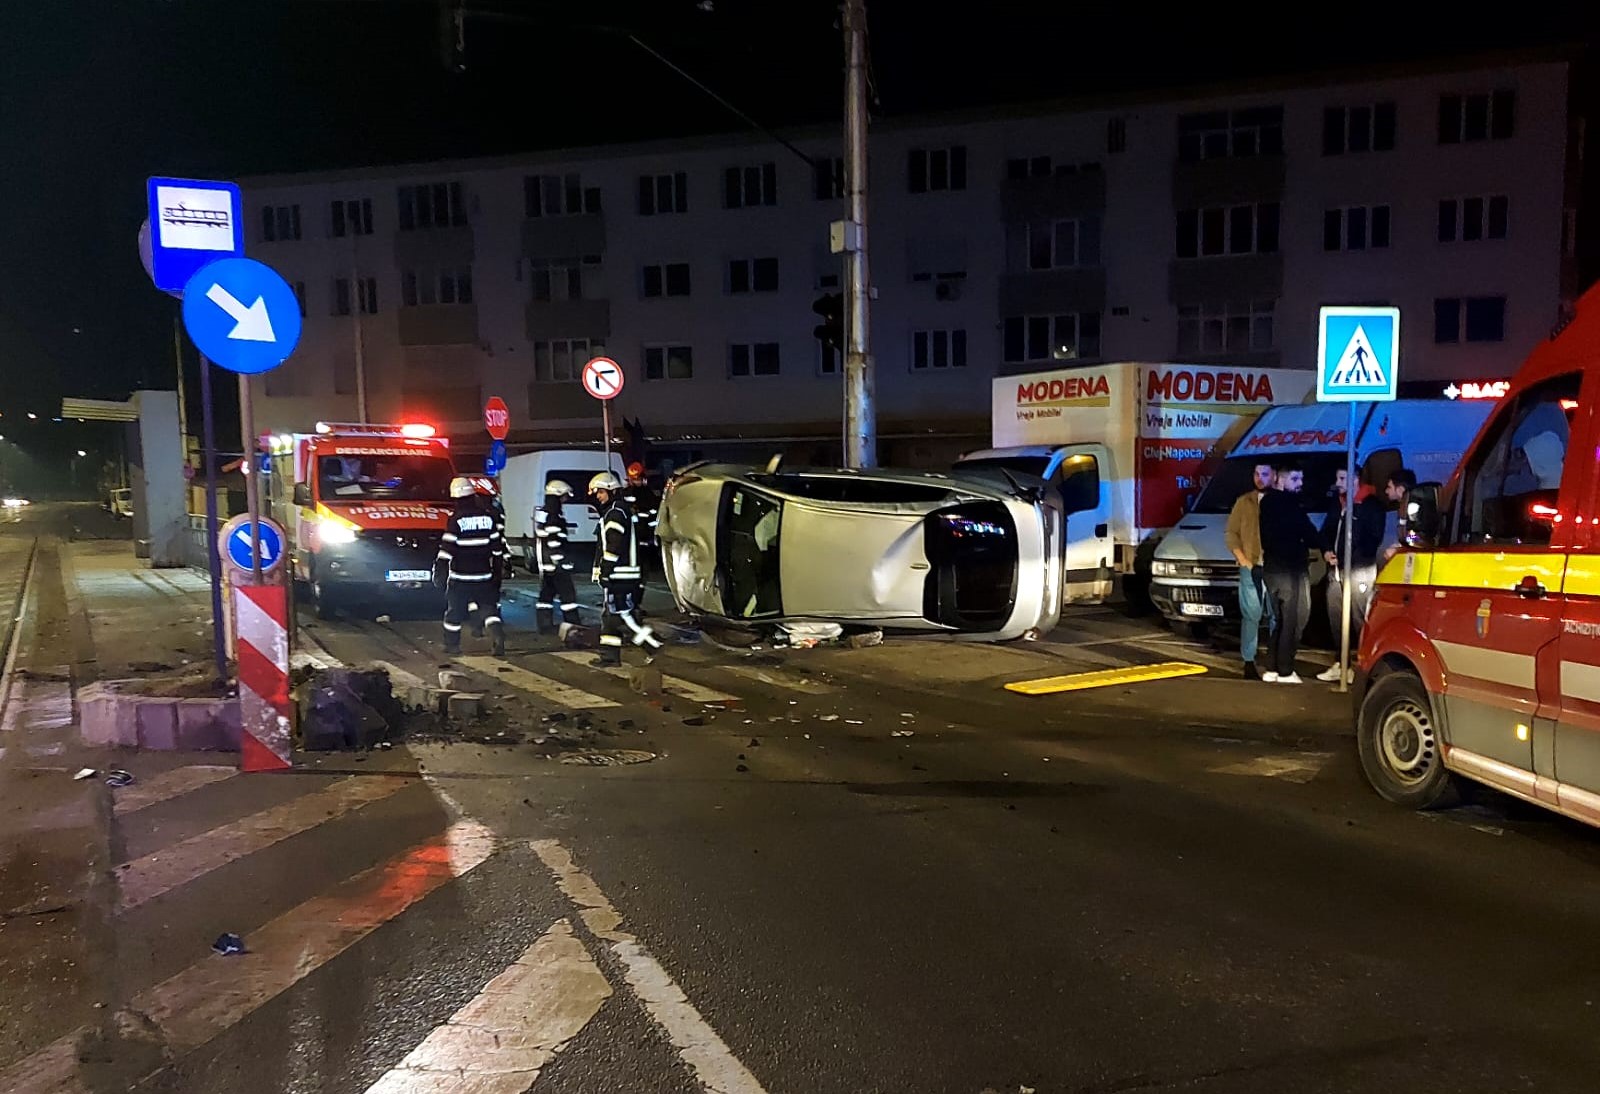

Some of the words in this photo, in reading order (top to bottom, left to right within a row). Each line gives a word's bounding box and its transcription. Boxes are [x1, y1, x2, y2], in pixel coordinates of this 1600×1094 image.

[1017, 374, 1110, 403] MODENA
[1147, 370, 1274, 402] MODENA
[485, 409, 507, 427] STOP
[1146, 414, 1173, 429] Vraja
[1244, 429, 1347, 449] MODENA
[335, 447, 433, 456] DESCARCERARE
